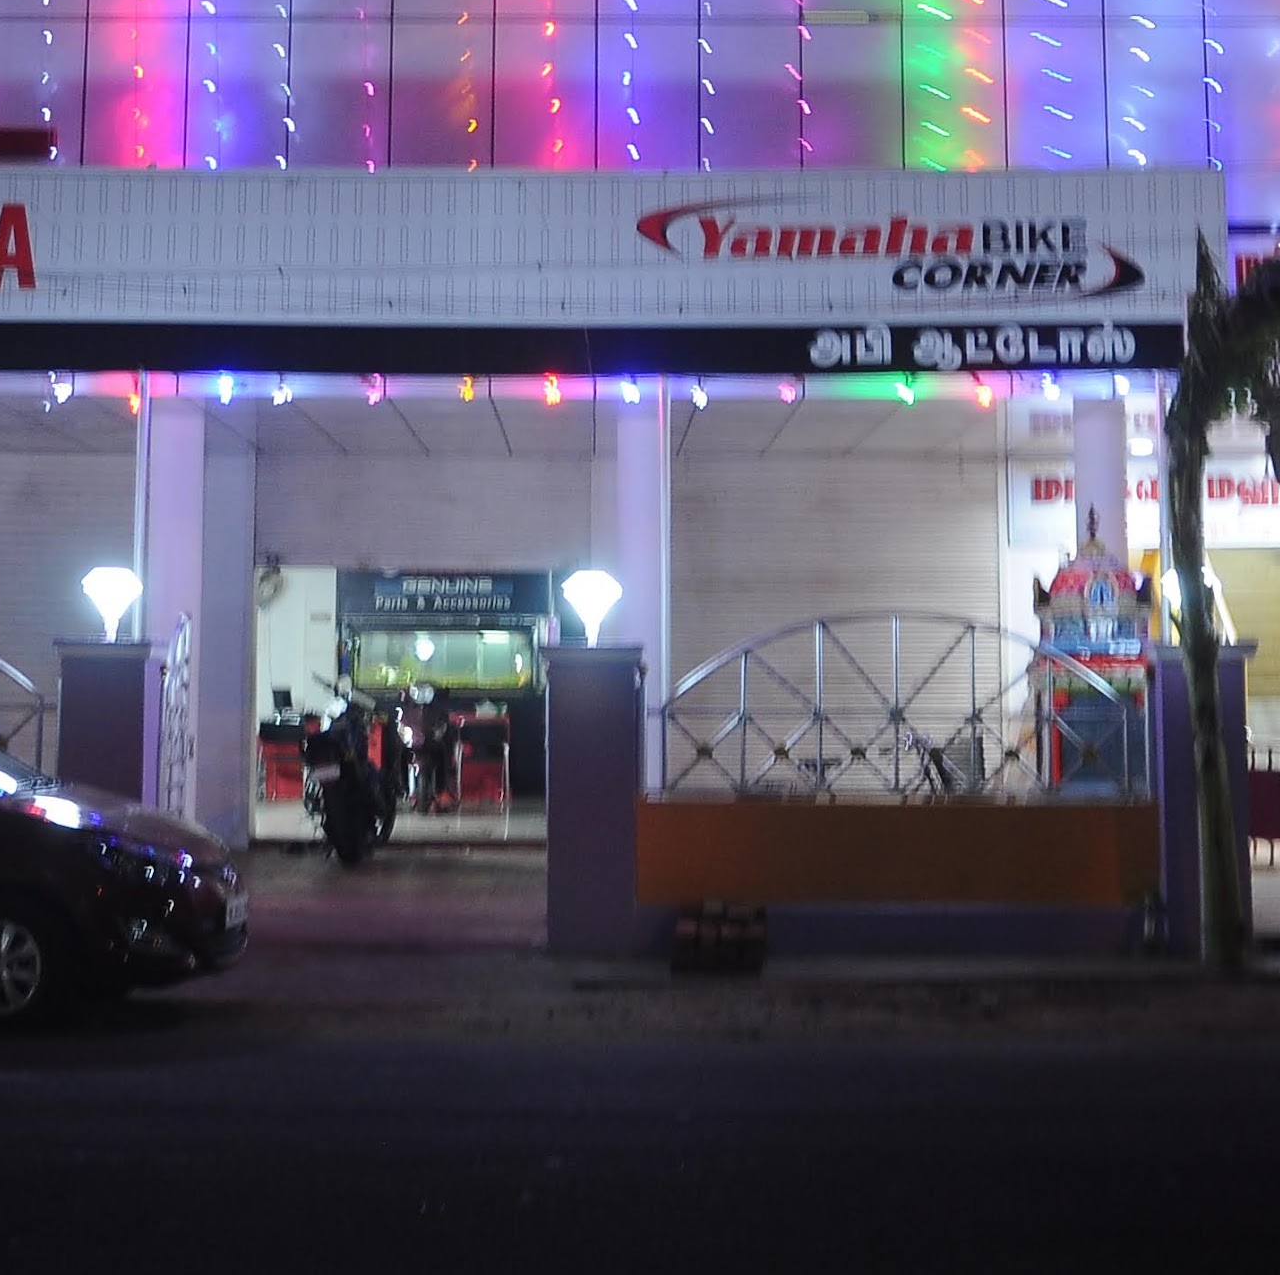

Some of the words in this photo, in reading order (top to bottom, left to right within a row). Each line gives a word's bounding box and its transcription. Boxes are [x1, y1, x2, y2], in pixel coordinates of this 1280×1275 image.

[697, 214, 976, 259] Yamaha
[982, 218, 1087, 254] BIKE
[892, 259, 1088, 292] CORNER
[808, 322, 892, 369] அபி
[912, 319, 1137, 371] ஆட்டோஸ்
[401, 575, 494, 595] GENUINE
[375, 595, 409, 611] Parts
[433, 594, 512, 611] Accessories
